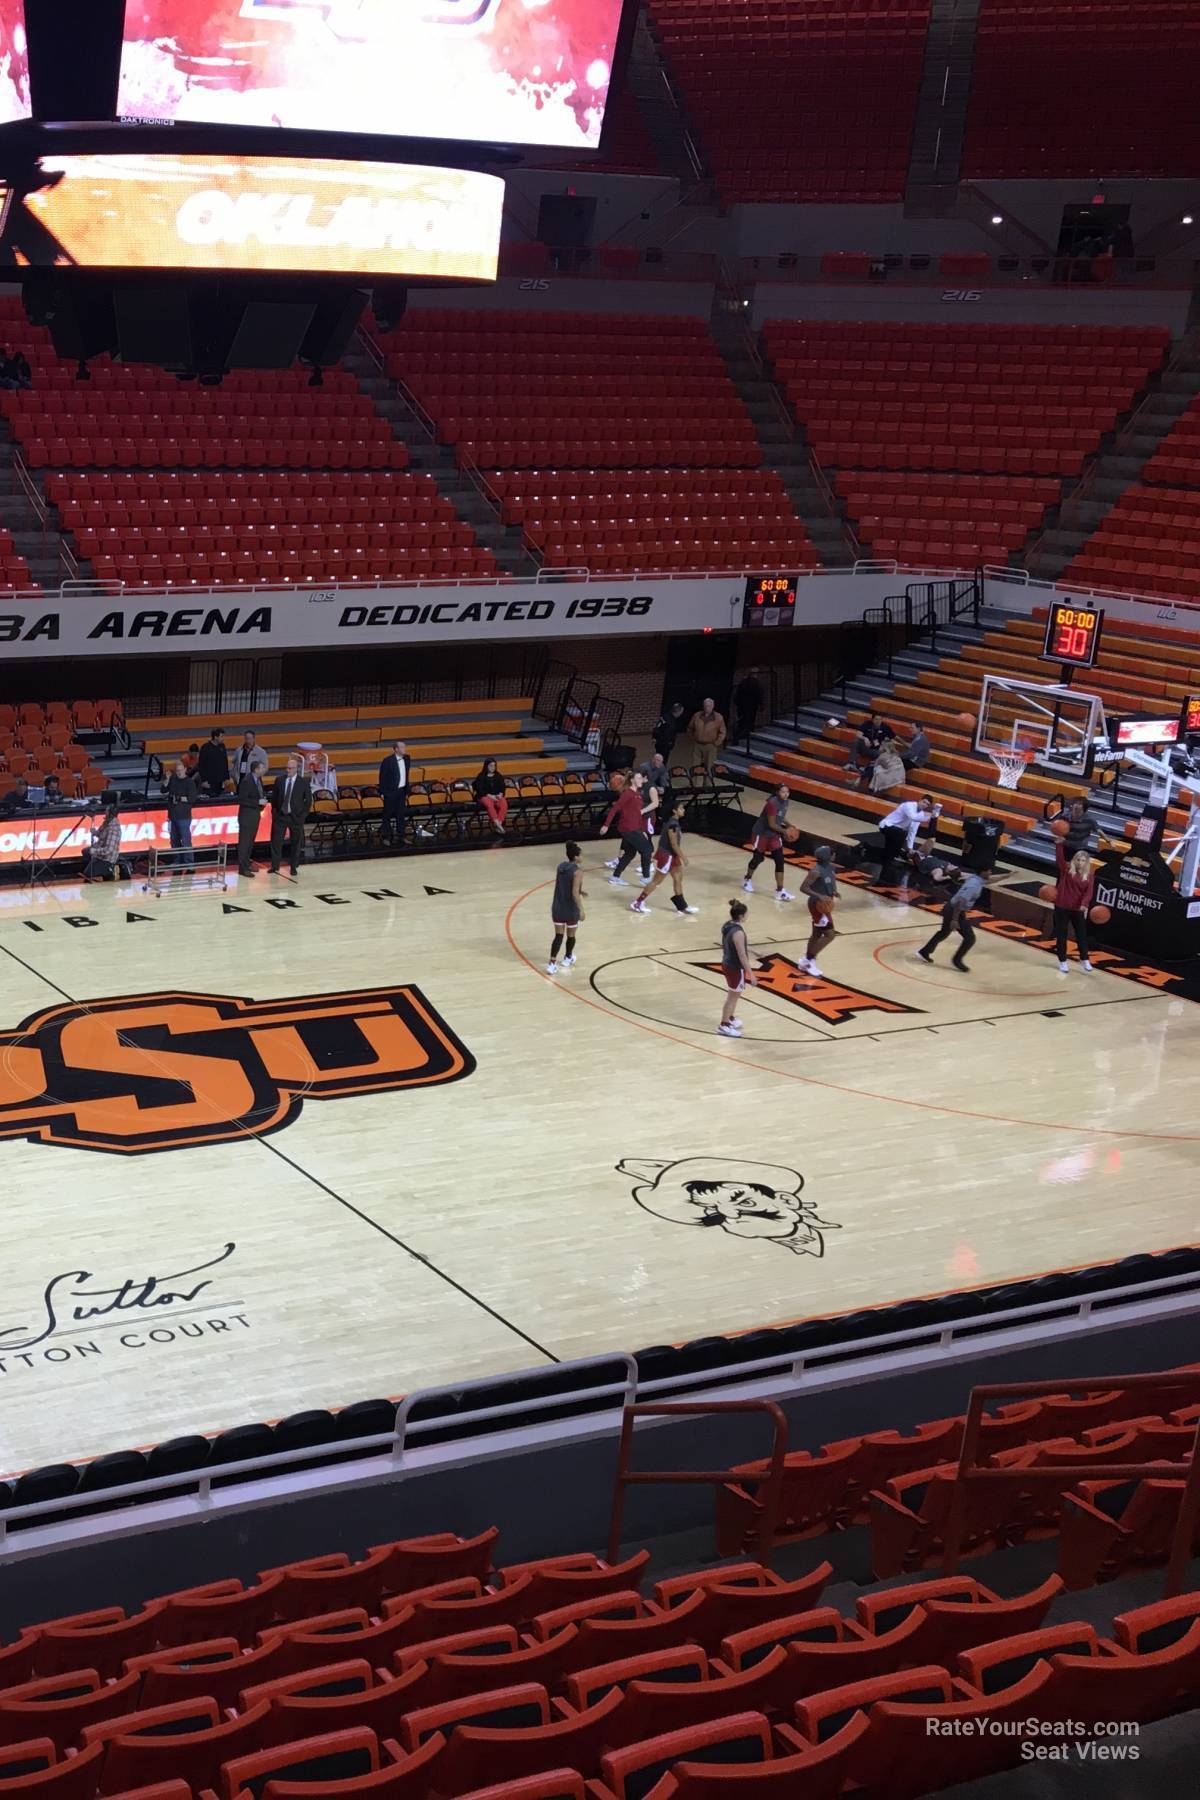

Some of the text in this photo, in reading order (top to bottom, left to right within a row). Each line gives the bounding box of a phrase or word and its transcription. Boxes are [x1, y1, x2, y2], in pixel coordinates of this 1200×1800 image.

[120, 116, 175, 126] DAKTRONICS
[519, 278, 551, 290] 215
[941, 289, 984, 301] 216
[87, 607, 272, 639] ARENA
[338, 596, 654, 627] DEDICATED 1938
[1056, 608, 1095, 629] 60:00
[1058, 626, 1088, 656] 30
[222, 884, 456, 915] ARENA
[119, 1313, 252, 1350] COURT
